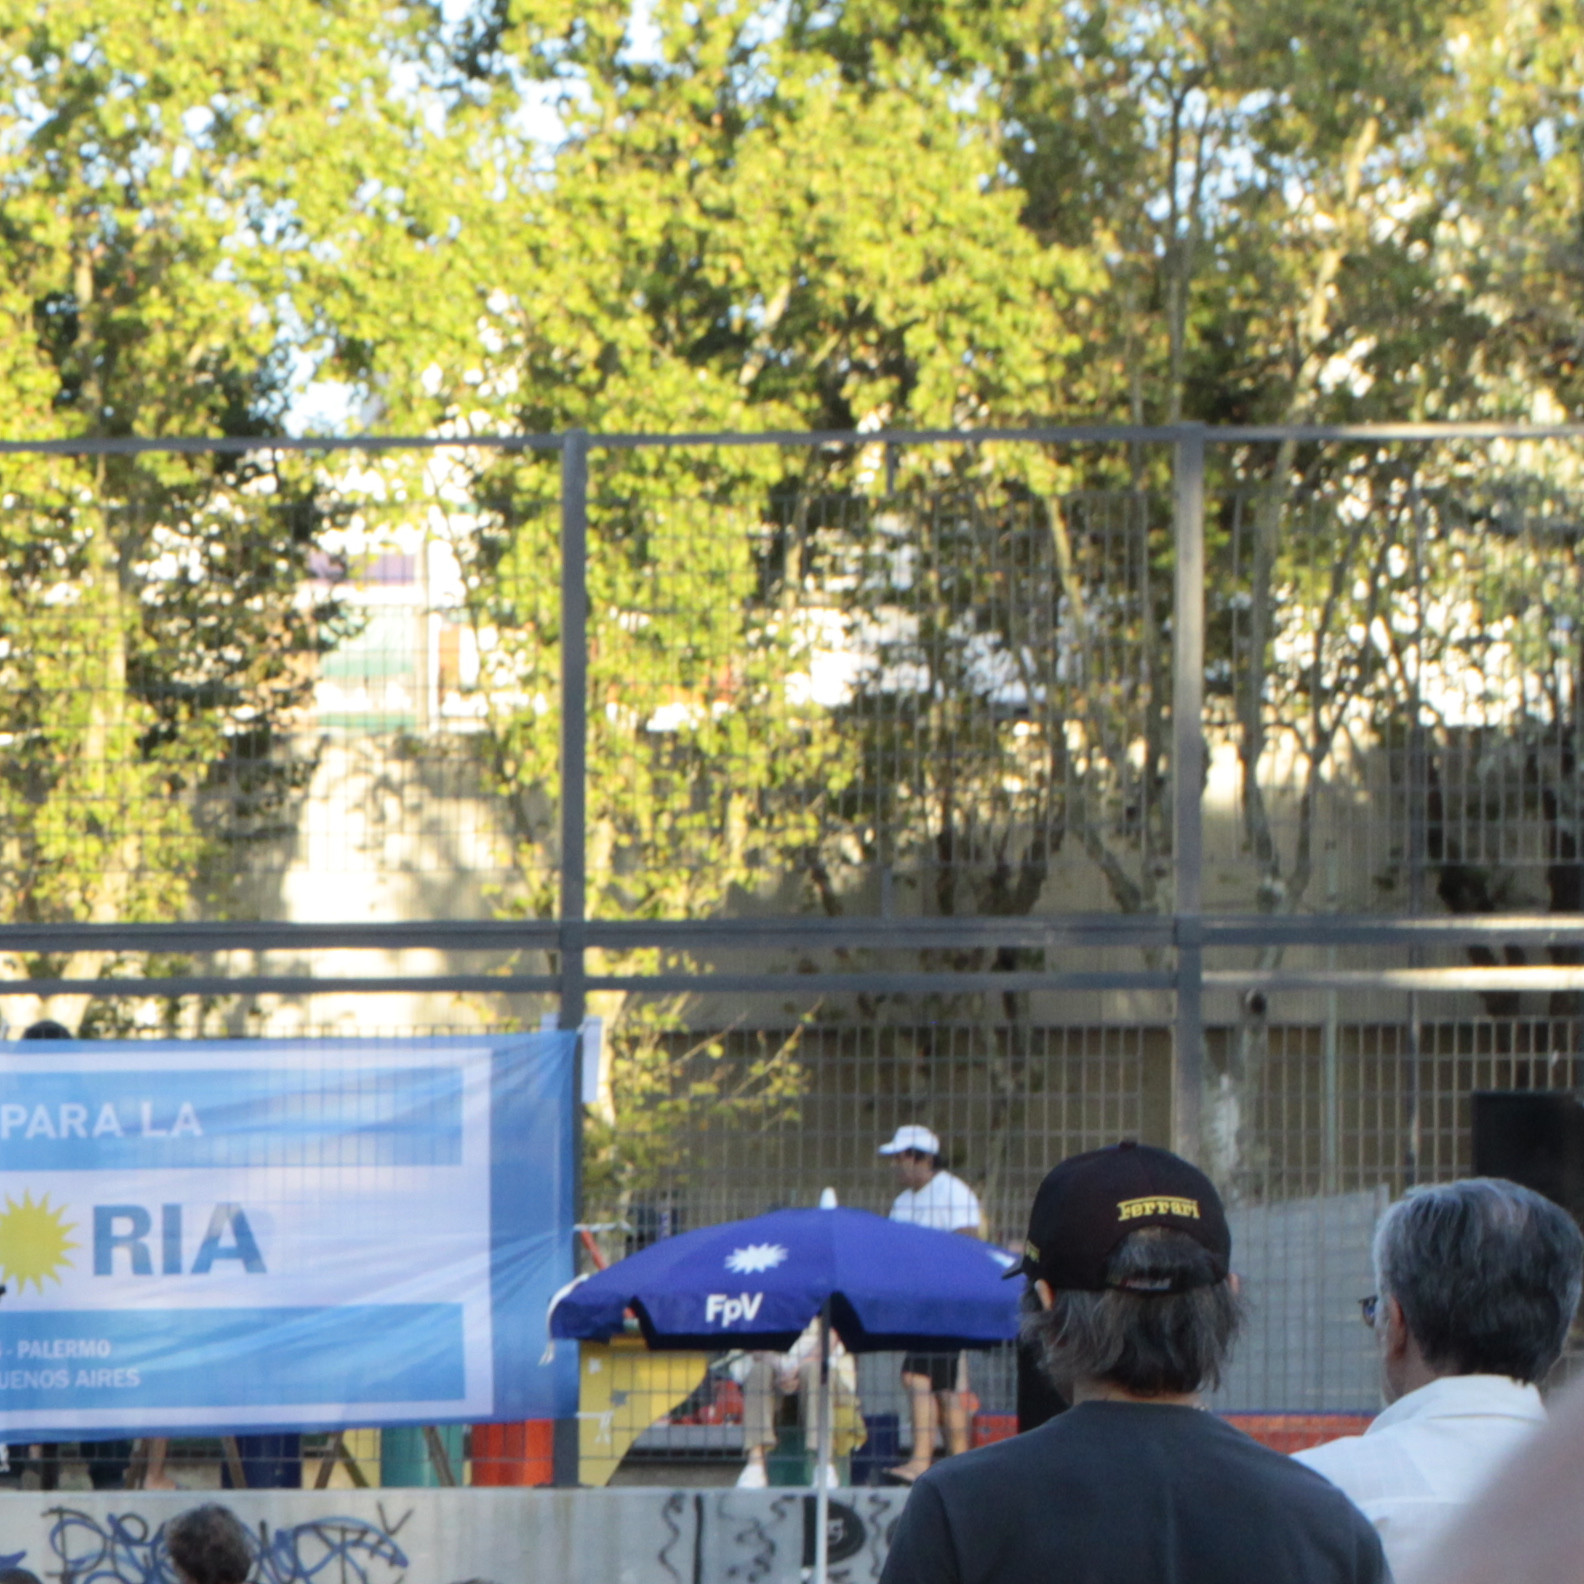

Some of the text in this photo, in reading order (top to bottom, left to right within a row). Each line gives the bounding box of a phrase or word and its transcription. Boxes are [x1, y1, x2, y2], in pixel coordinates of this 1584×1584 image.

[0, 1102, 124, 1139] PARA
[143, 1102, 202, 1138] LA
[1117, 1196, 1200, 1222] Ferrari
[705, 1292, 763, 1328] FpV
[17, 1339, 112, 1360] PALERMO
[75, 1367, 141, 1389] AIRES
